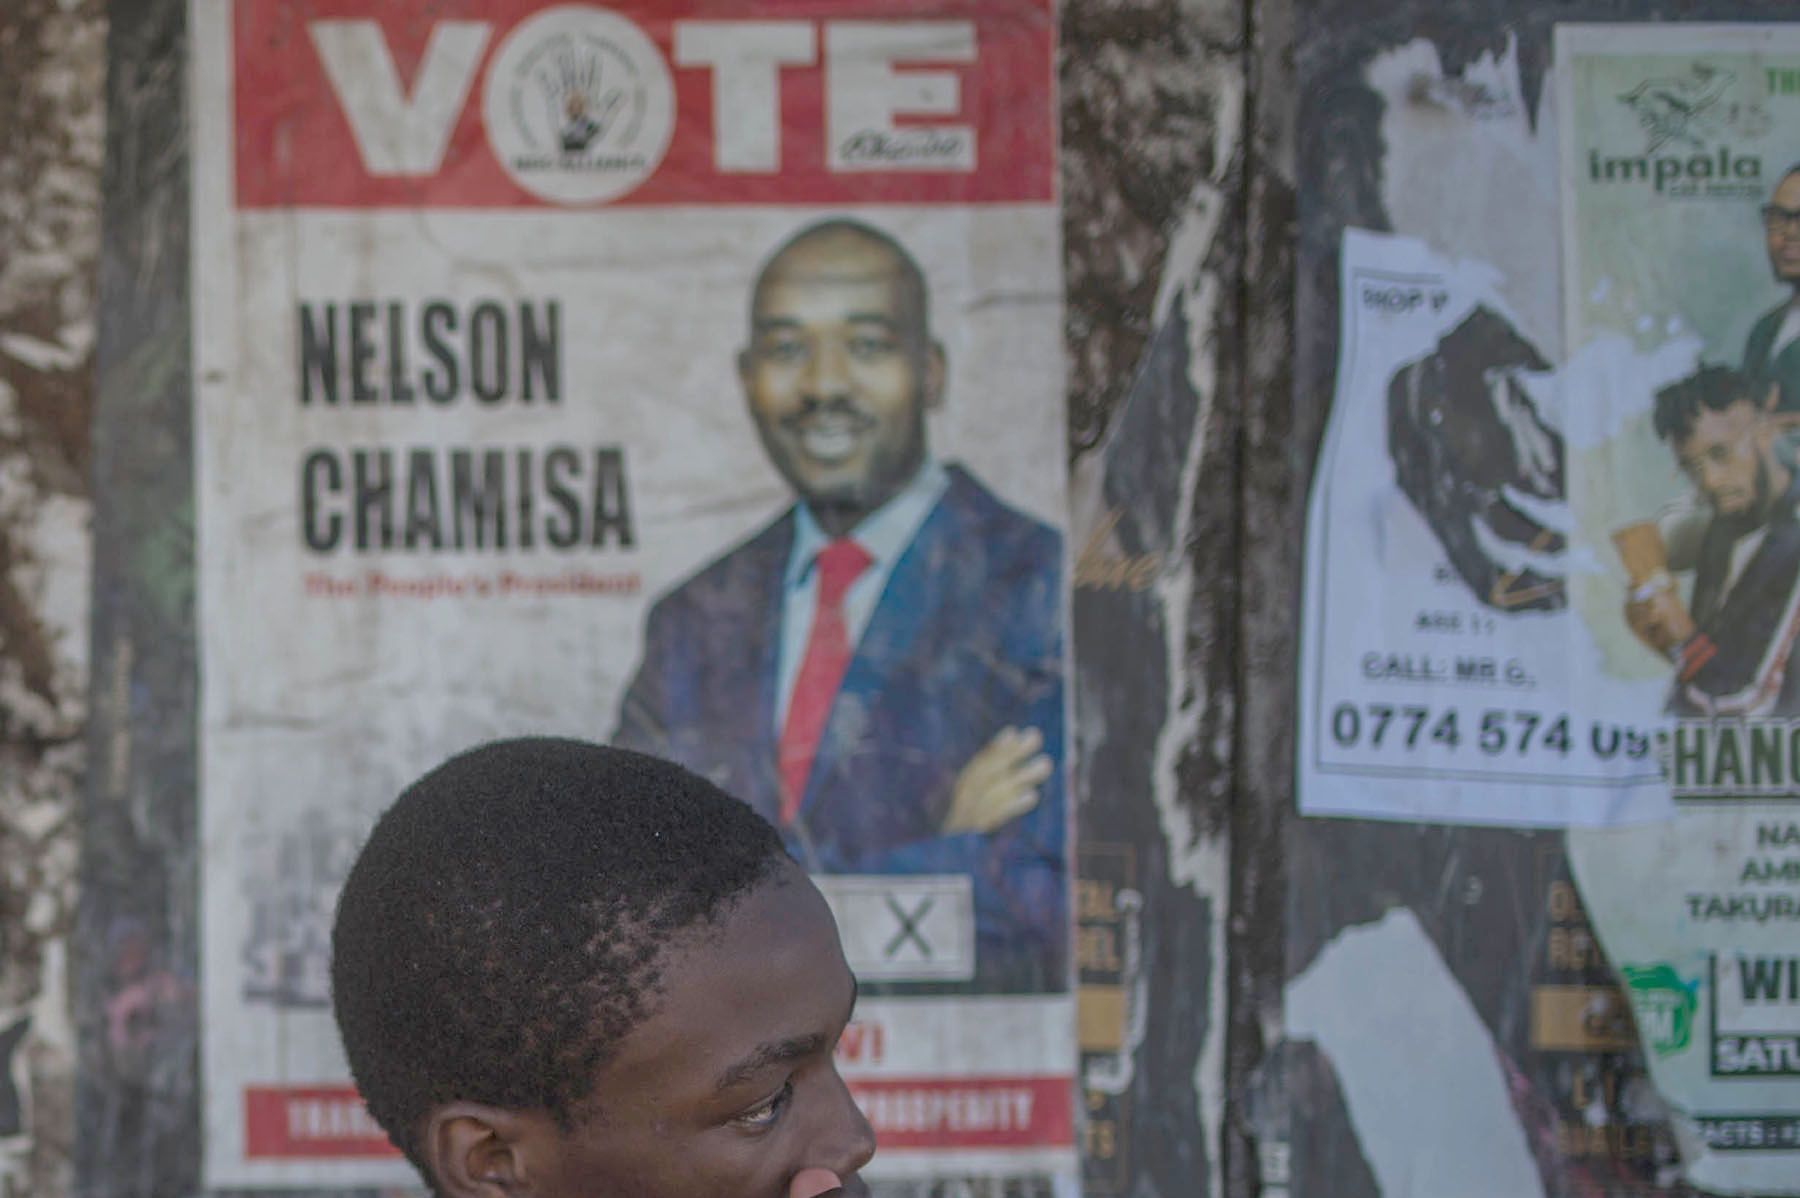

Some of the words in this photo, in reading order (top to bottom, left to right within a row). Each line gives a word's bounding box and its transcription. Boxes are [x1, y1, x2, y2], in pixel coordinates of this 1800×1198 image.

[307, 4, 978, 203] VOTE
[1589, 148, 1762, 193] impala
[299, 302, 562, 405] NELSON
[300, 446, 638, 554] CHAMISA
[1332, 704, 1460, 751] 0774
[1478, 708, 1575, 757] 574
